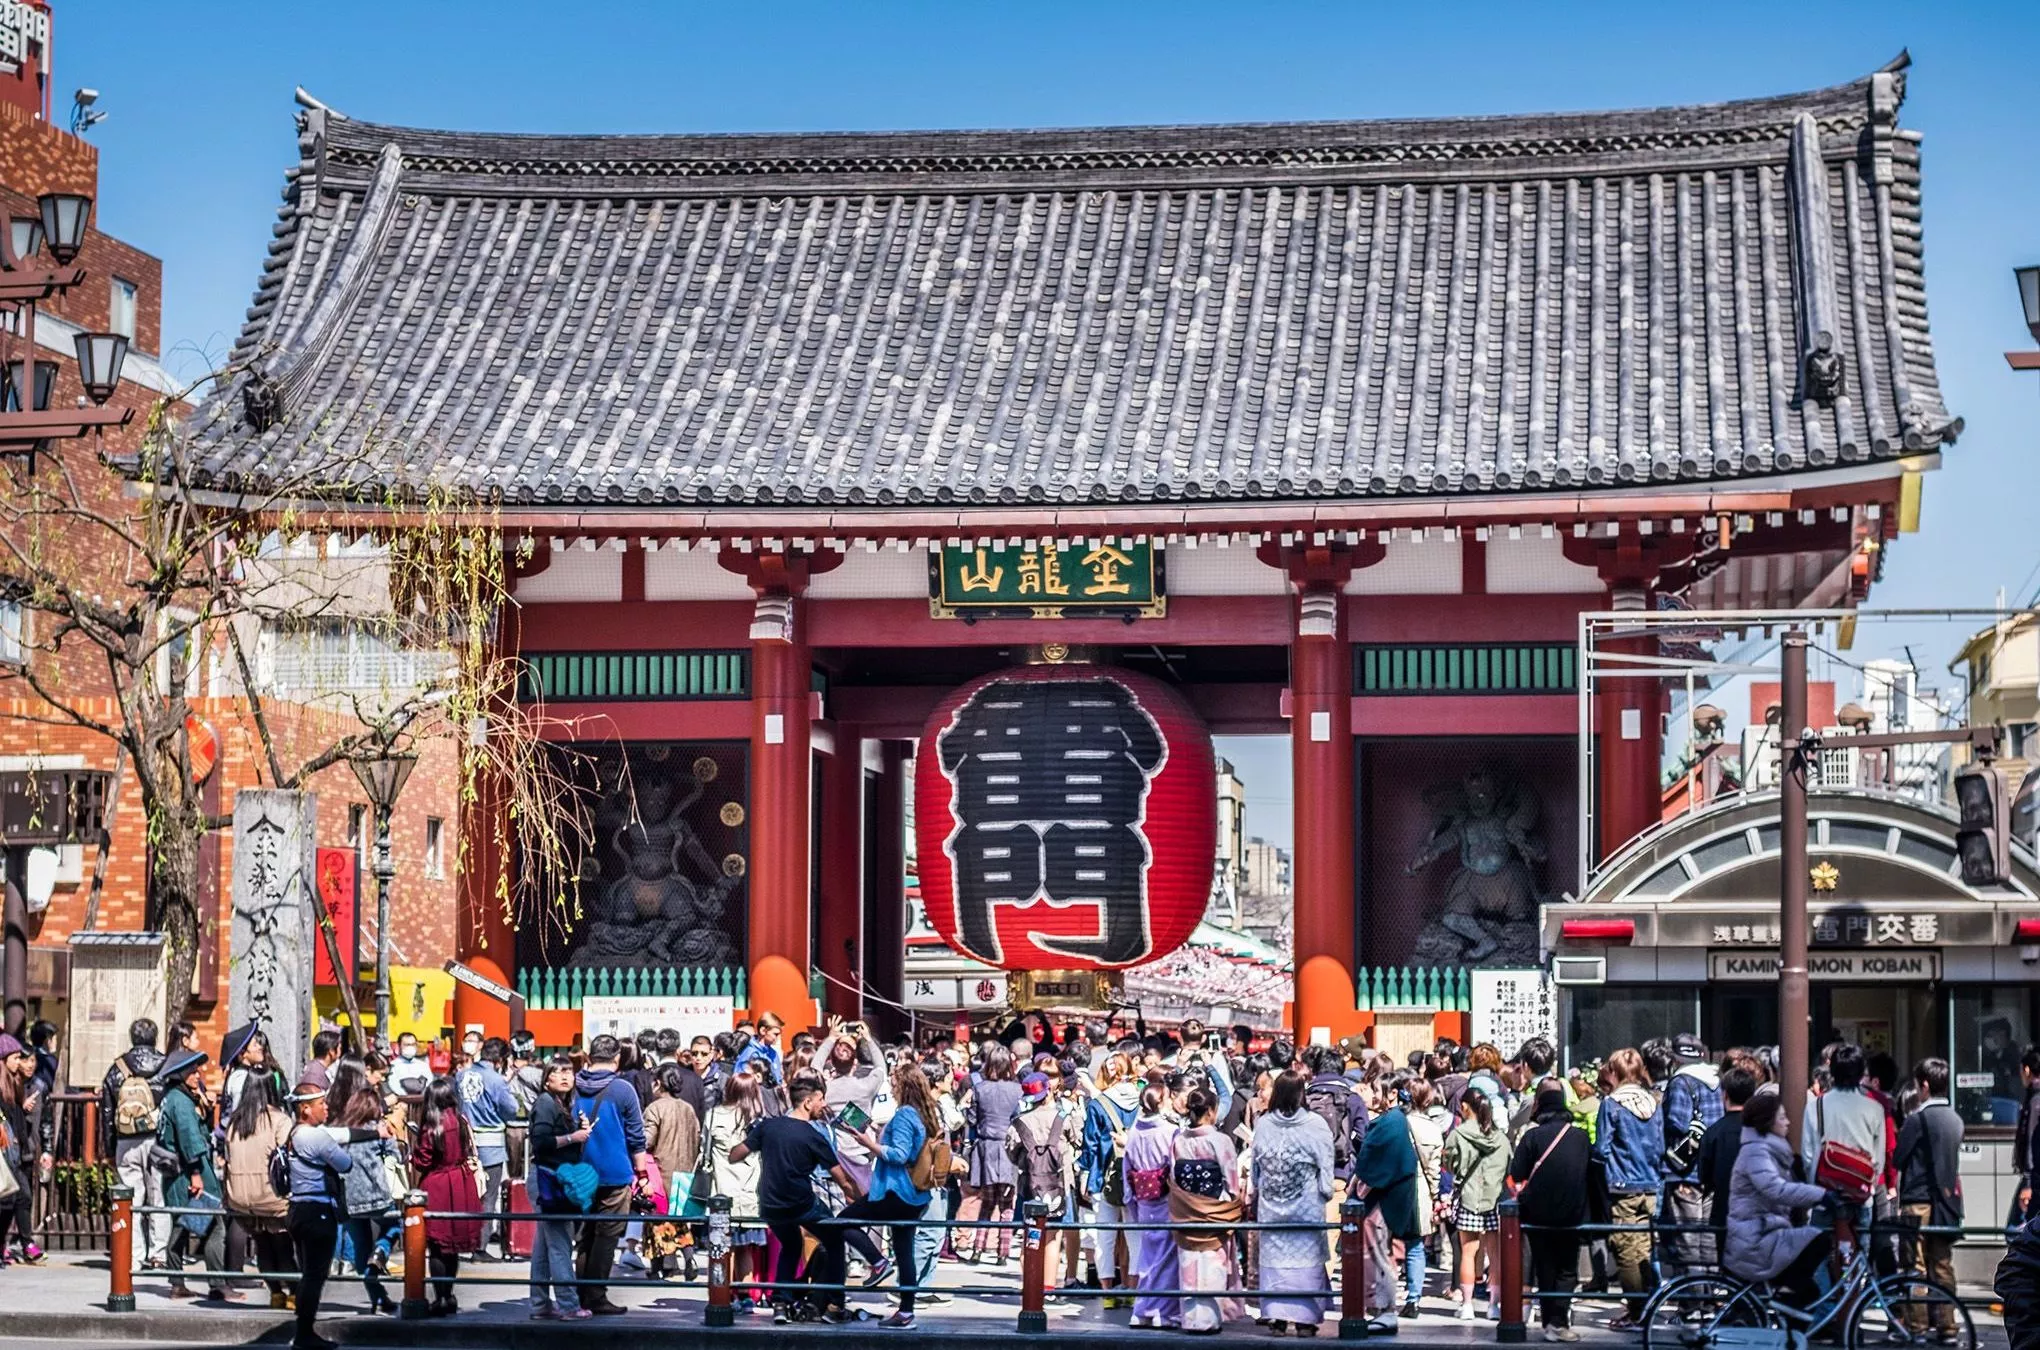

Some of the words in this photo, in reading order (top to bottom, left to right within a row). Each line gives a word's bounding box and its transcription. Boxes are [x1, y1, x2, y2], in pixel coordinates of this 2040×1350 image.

[936, 676, 1169, 964] 雷門
[1812, 914, 1938, 943] 雷門交番
[1726, 958, 1852, 974] KAMINIMON
[1862, 958, 1923, 974] KOBAN
